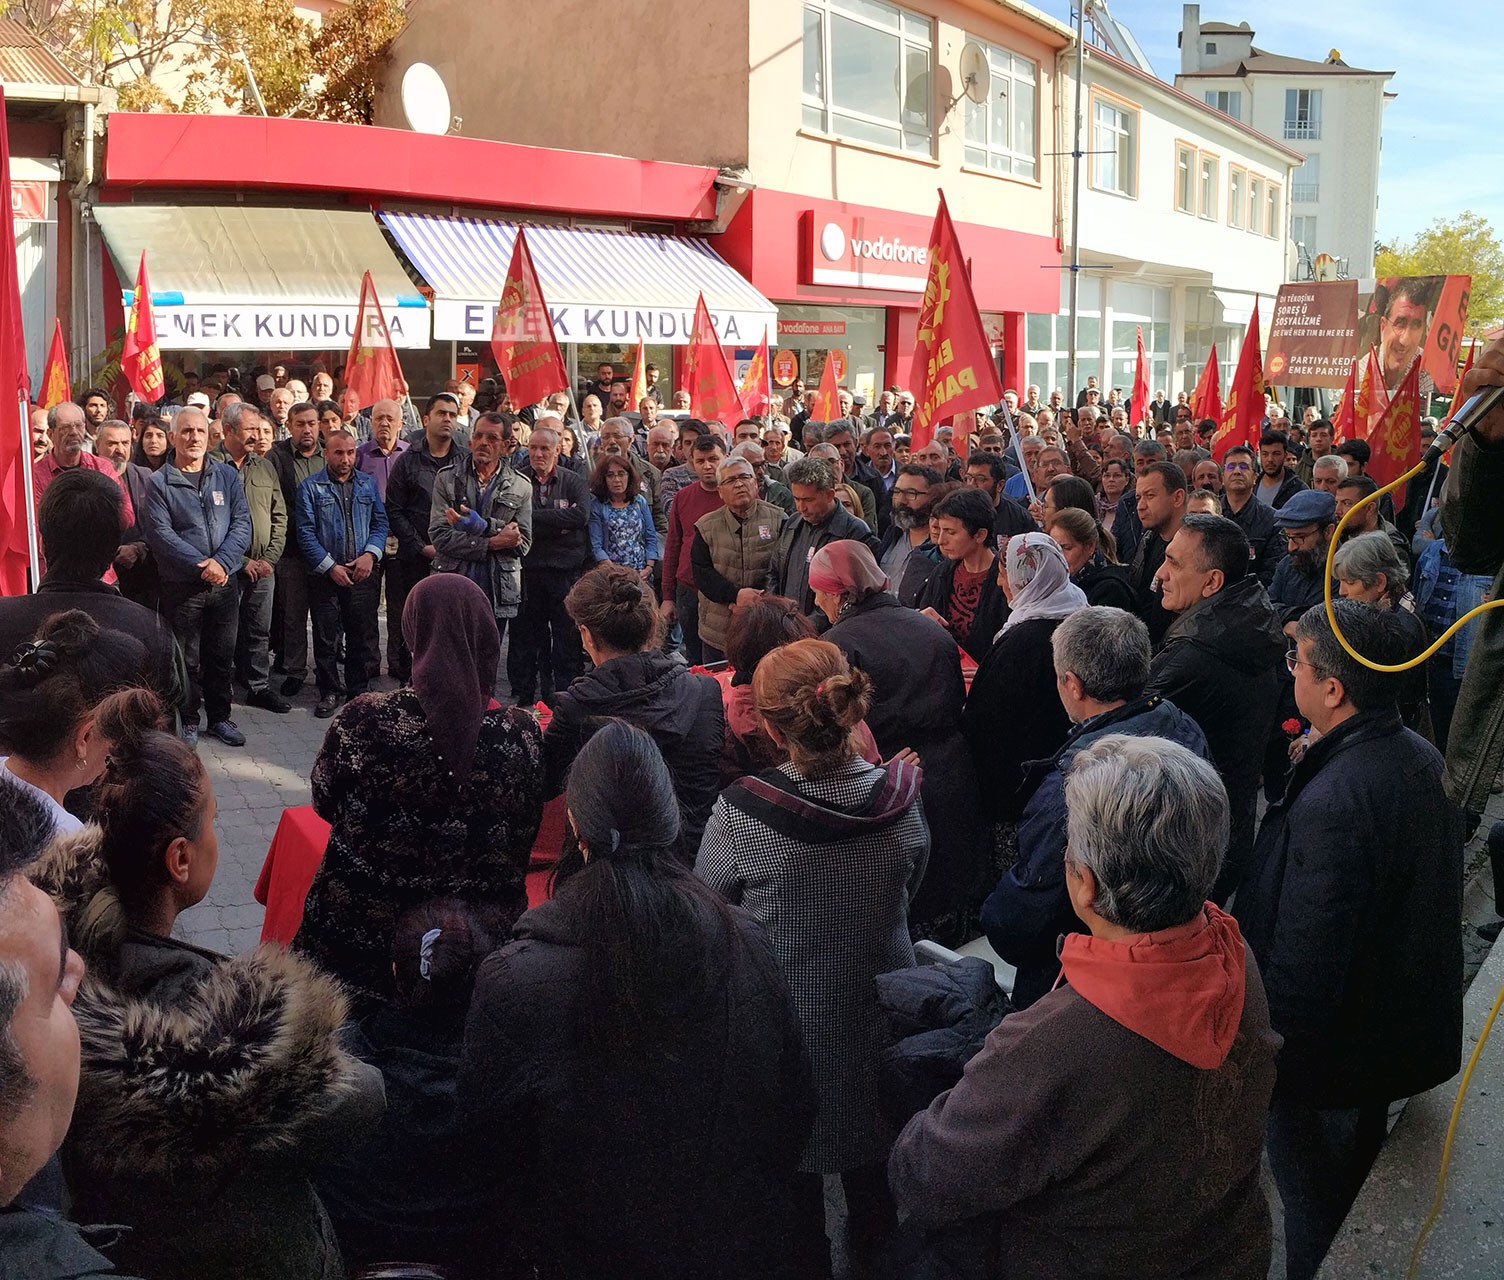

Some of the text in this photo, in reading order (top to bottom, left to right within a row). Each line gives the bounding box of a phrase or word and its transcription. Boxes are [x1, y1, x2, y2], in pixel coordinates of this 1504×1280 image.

[850, 236, 927, 265] vodafone
[255, 313, 405, 338] KUNDURA
[465, 304, 742, 341] EMEK KUNDURA
[783, 322, 820, 334] vodafone
[1290, 355, 1329, 365] PARTIYA
[1288, 365, 1353, 377] EMEK PARTİSİ
